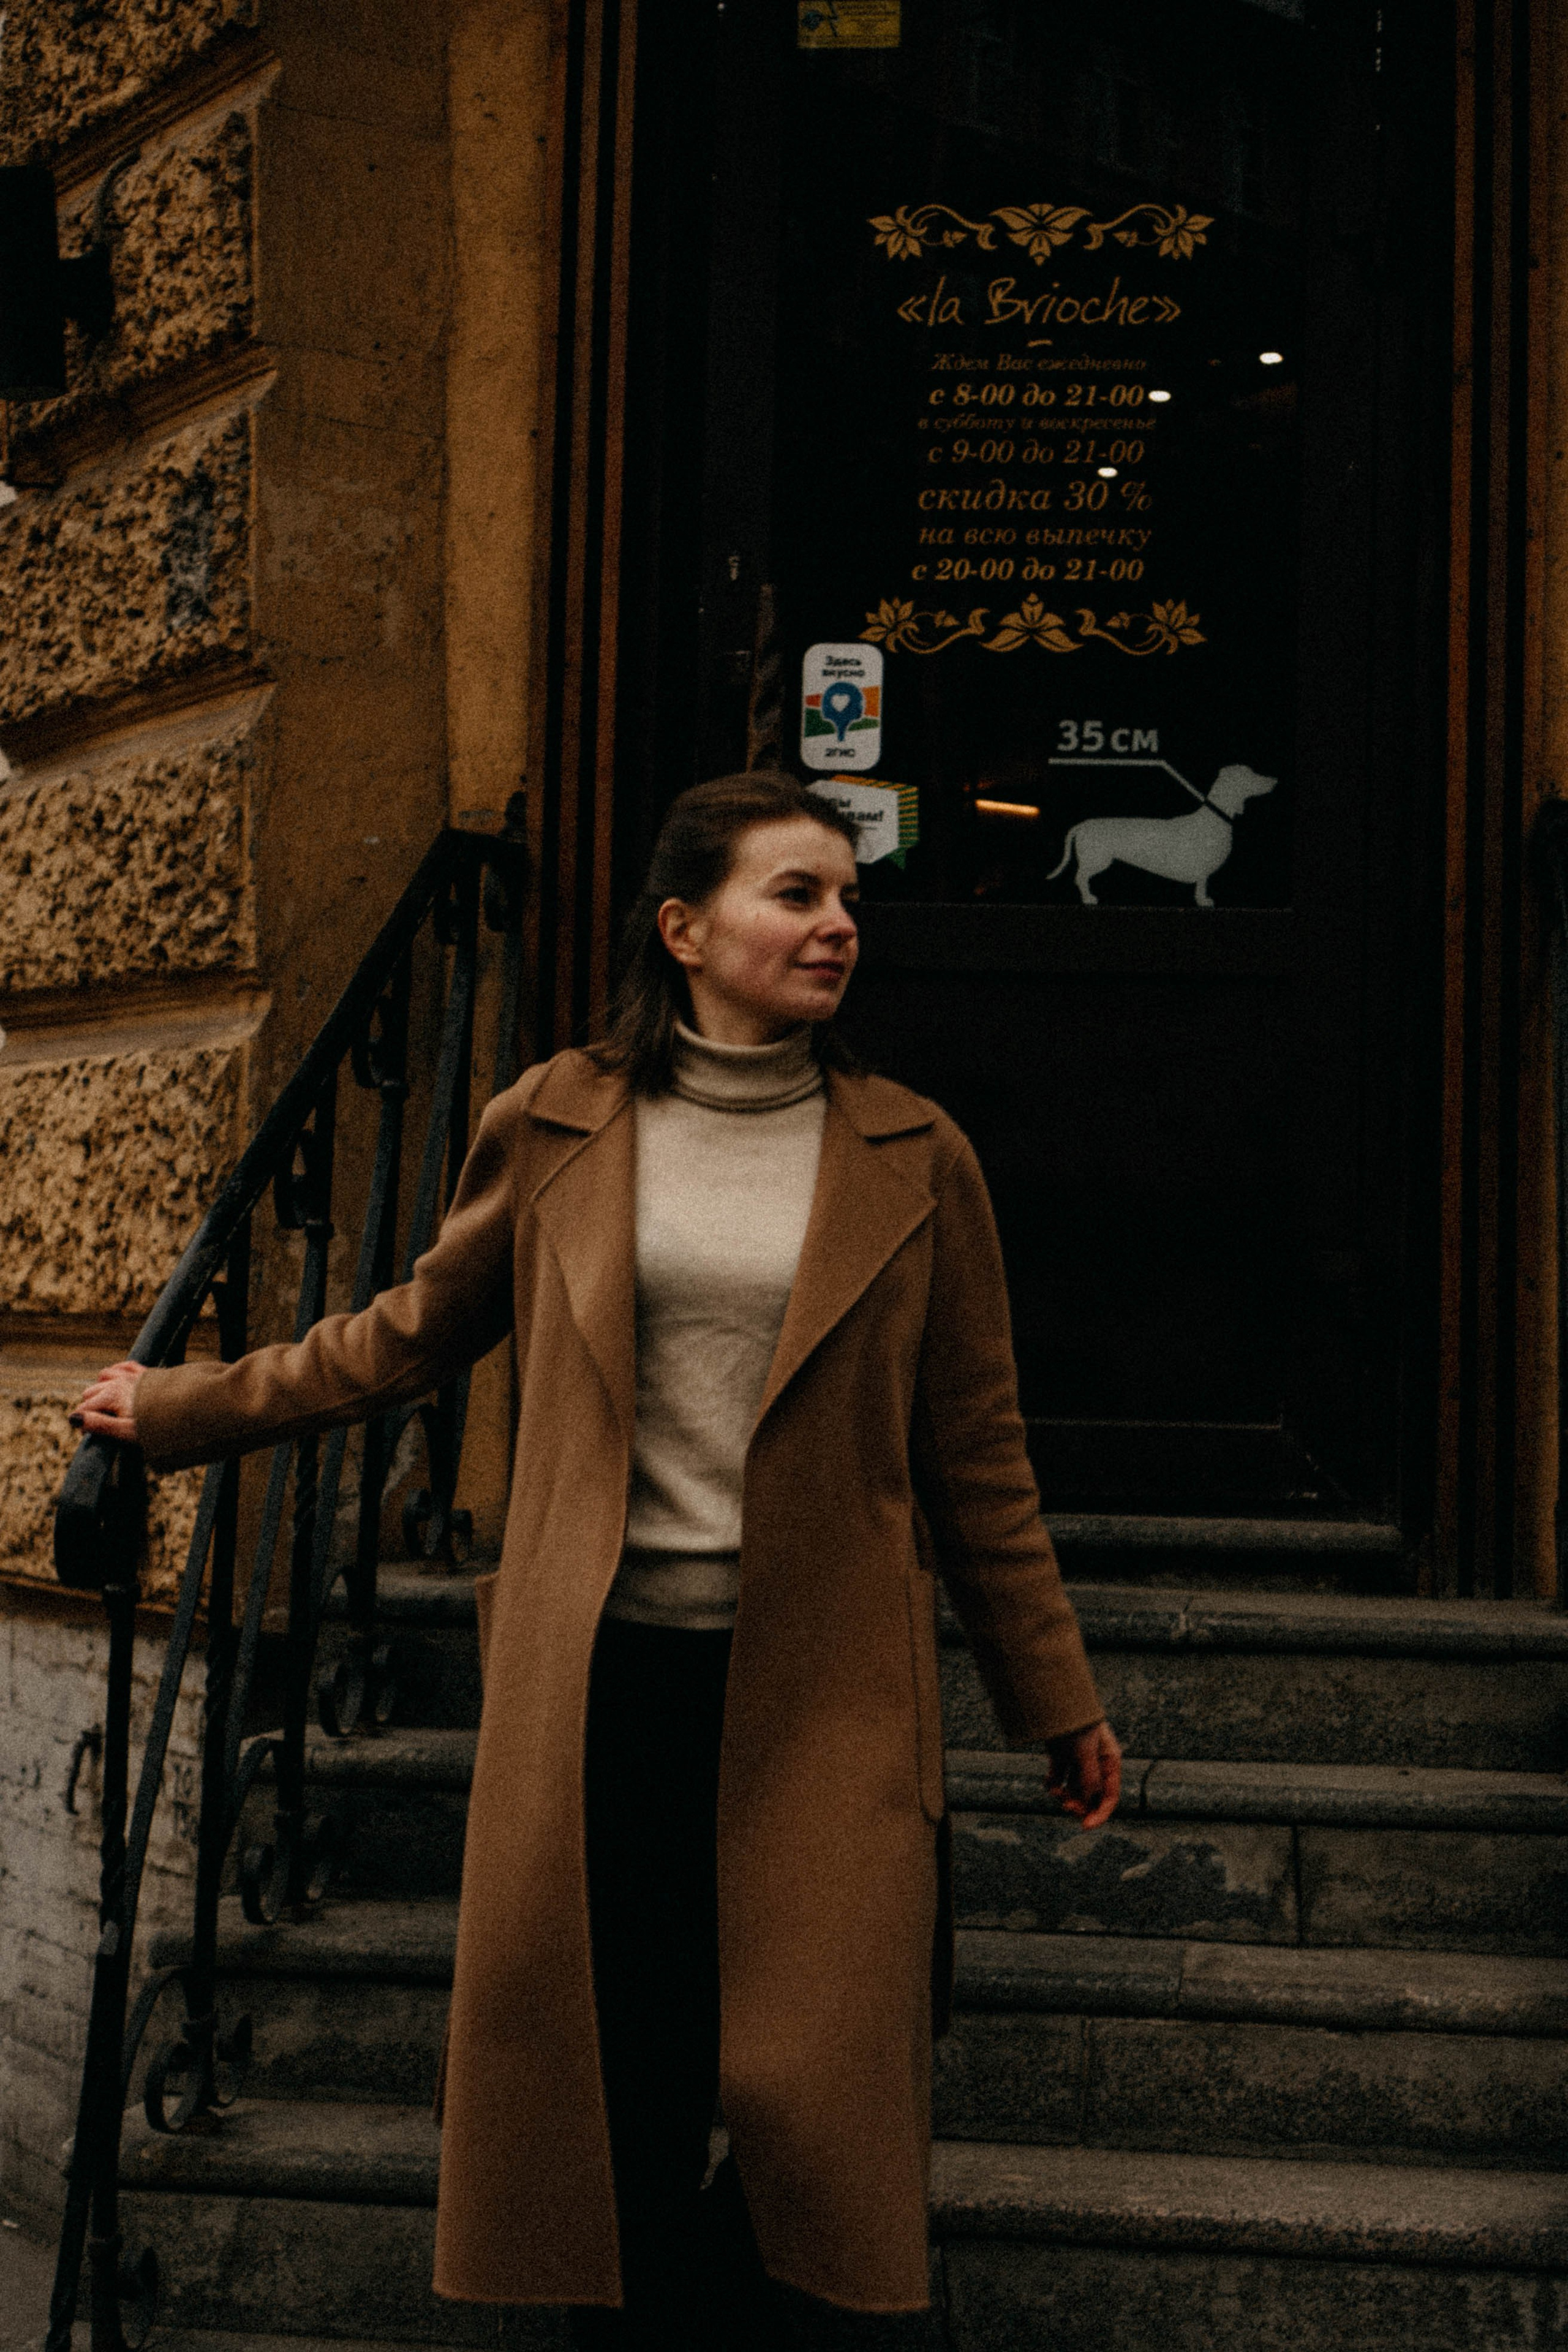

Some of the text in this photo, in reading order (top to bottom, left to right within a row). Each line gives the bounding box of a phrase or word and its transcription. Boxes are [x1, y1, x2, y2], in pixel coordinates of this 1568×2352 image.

[928, 382, 1145, 408] с 8-00 до 21-00
[933, 412, 1017, 434] субботу
[1020, 418, 1035, 429] и
[1040, 417, 1158, 435] воскресенье
[927, 437, 1146, 465] с 9-00 до 21-00
[919, 478, 1154, 512] скидка 30 %
[919, 526, 1153, 552] на всю выпечку
[910, 556, 1146, 582] с 20-00 до 21-00
